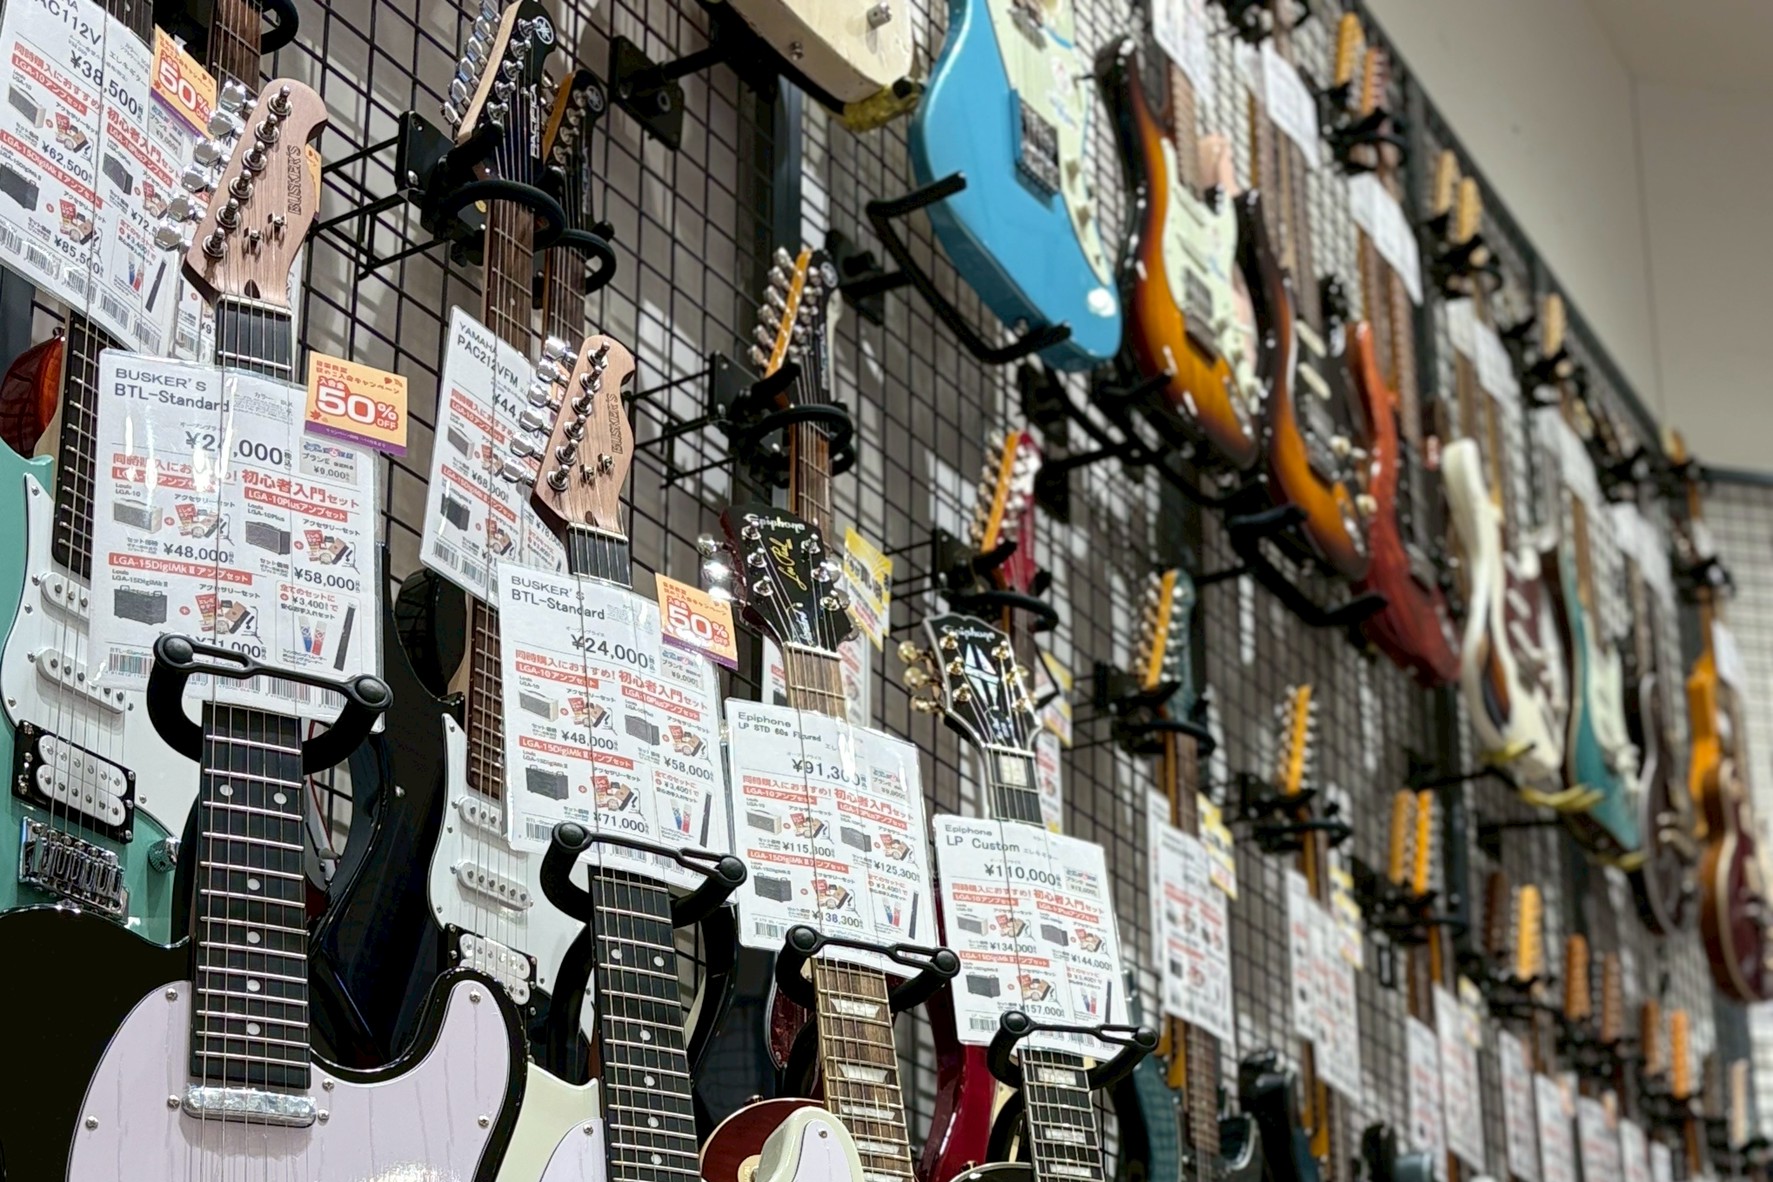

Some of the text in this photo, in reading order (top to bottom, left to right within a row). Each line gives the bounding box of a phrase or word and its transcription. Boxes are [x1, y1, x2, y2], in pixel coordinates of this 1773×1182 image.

[70, 49, 138, 115] ¥38,500
[530, 83, 541, 159] PACIFICA
[42, 140, 89, 182] ¥62,500
[54, 234, 100, 275] ¥85,500
[460, 321, 498, 357] YAMAHA
[457, 334, 518, 388] PAC212VFM
[114, 383, 230, 413] BTL-Standard
[377, 418, 397, 430] OFF
[185, 430, 283, 466] ¥2,000
[241, 468, 359, 509] 初心者入門セット
[163, 542, 228, 564] ¥48,000
[294, 566, 355, 592] ¥58,000
[511, 588, 605, 620] BTL-Standard
[571, 634, 648, 669] ¥24,000
[618, 670, 708, 710] 初心者入門セット
[738, 711, 791, 728] Epiphone
[738, 721, 749, 730] LP
[753, 724, 771, 734] STD
[561, 729, 614, 751] ¥48,000
[663, 755, 711, 780] ¥58,000
[593, 810, 645, 833] ¥71,000
[944, 824, 993, 837] Epiphone
[946, 835, 963, 846] LP
[972, 837, 1020, 853] Custom
[983, 863, 1056, 886] ¥110,000
